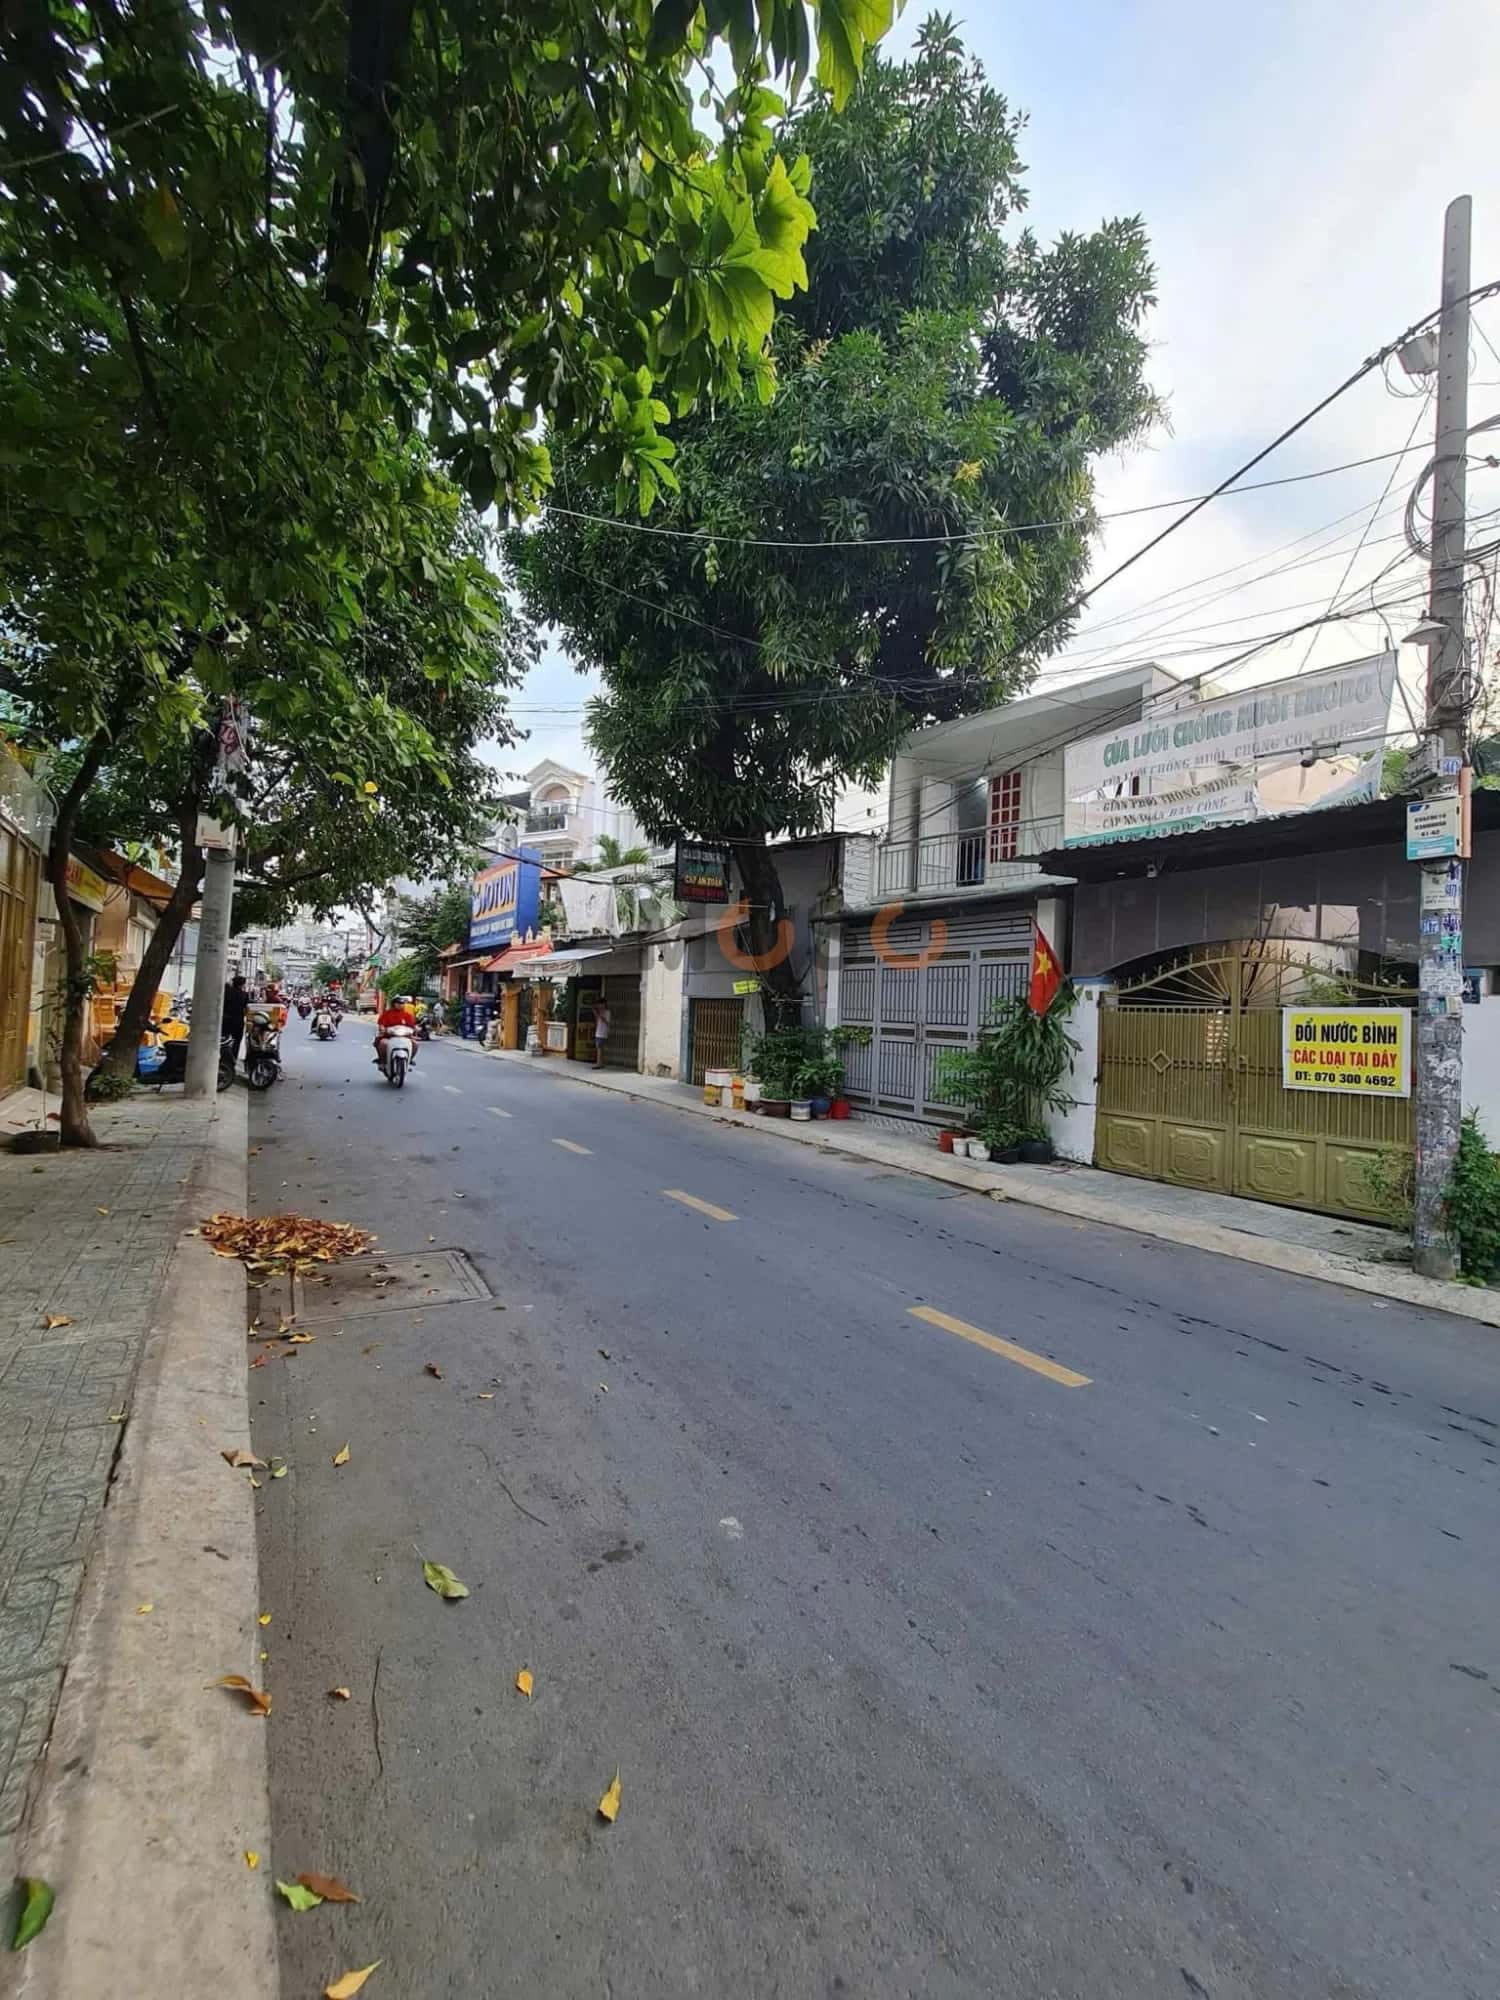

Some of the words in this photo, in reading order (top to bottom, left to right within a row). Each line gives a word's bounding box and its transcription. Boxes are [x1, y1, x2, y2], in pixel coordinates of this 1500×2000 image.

[1295, 1017, 1317, 1042] ĐỔI
[1321, 1021, 1358, 1044] NƯỚC
[1362, 1021, 1398, 1045] BÌNH
[1293, 1048, 1317, 1065] CÁC
[1319, 1050, 1346, 1070] LOẠI
[1349, 1051, 1369, 1071] TẠI
[1372, 1049, 1398, 1069] ĐÂY
[1314, 1072, 1336, 1083] 070
[1339, 1073, 1361, 1085] 300
[1365, 1074, 1396, 1087] 4692
